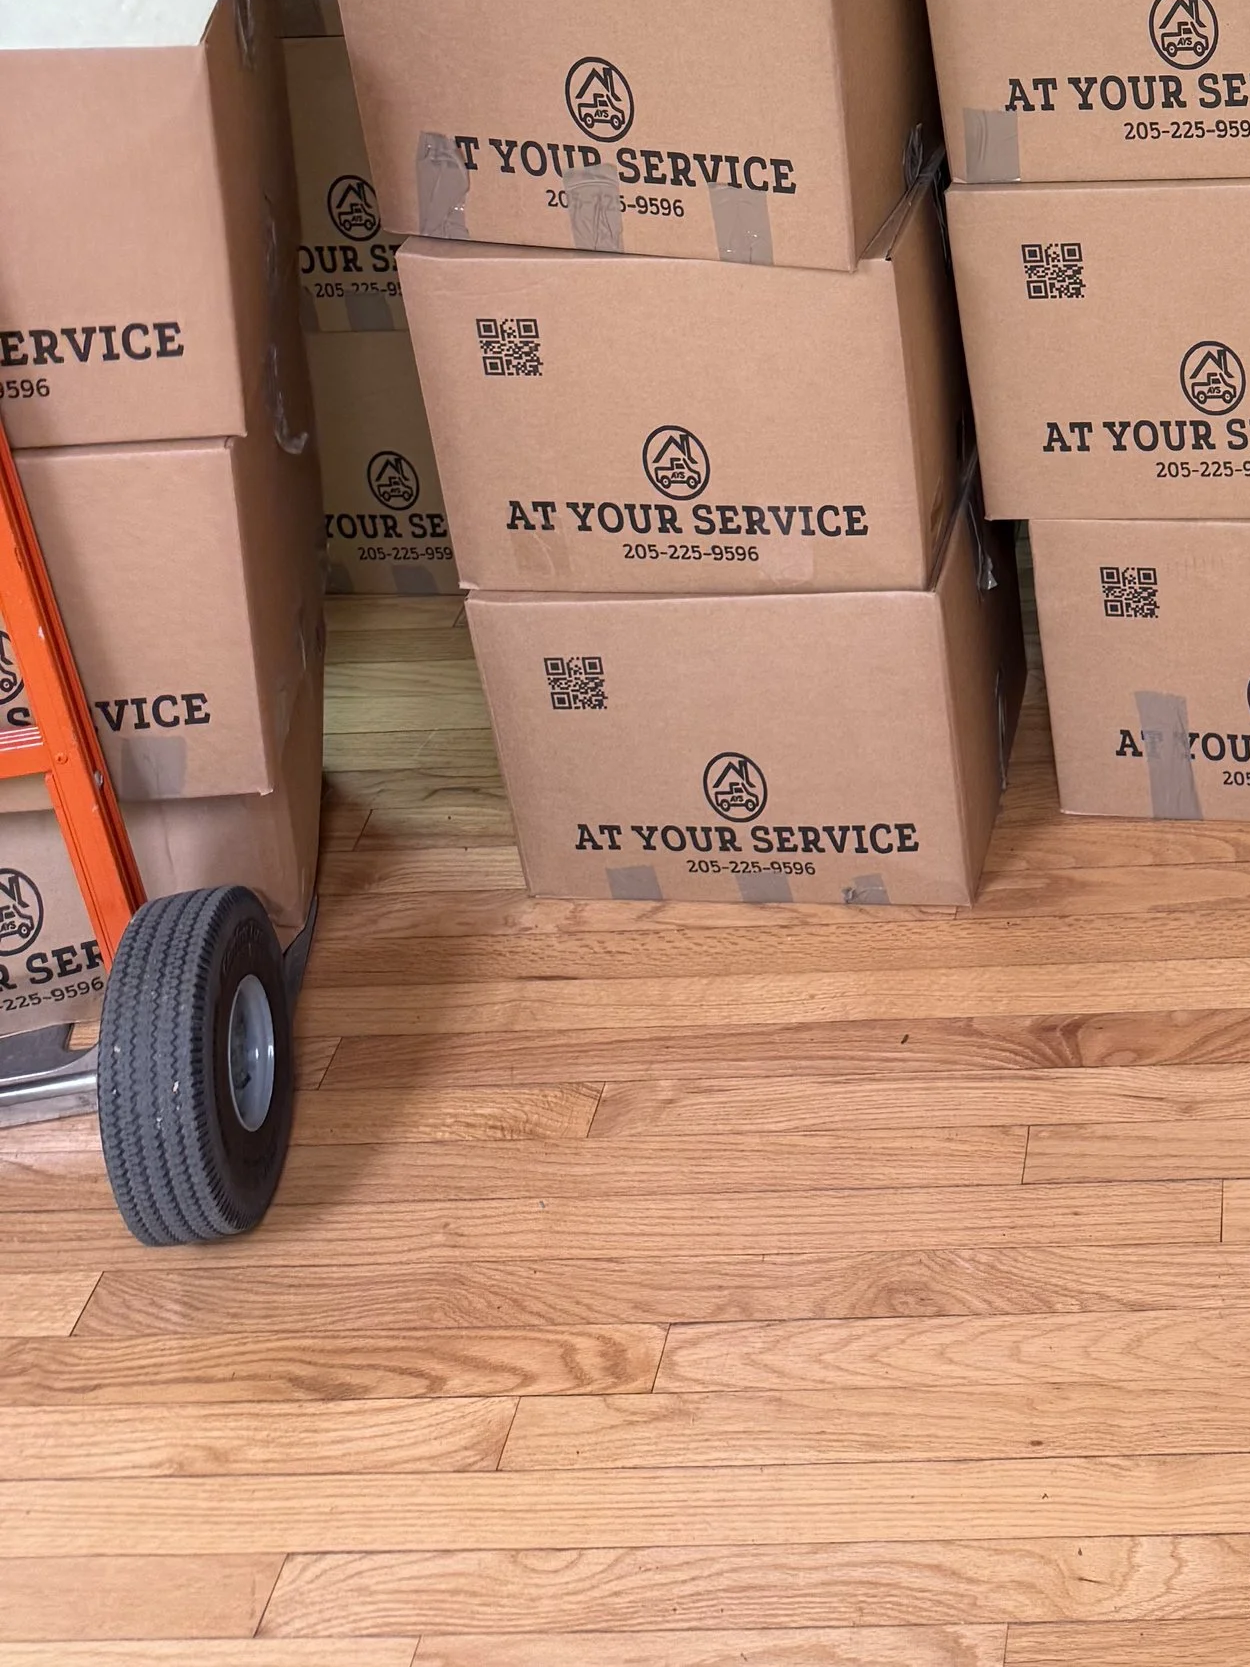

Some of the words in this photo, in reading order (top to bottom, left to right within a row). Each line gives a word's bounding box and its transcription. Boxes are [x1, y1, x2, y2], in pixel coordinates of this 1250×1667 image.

[1177, 37, 1193, 46] AYS
[1005, 78, 1057, 111] AT
[1068, 74, 1187, 110] YOUR
[594, 109, 609, 118] AYS
[617, 148, 796, 194] SERVICE
[1206, 386, 1222, 394] AYS
[1043, 422, 1092, 452] AT
[1103, 420, 1216, 451] YOUR
[670, 471, 685, 480] AYS
[507, 501, 556, 531] AT
[566, 502, 682, 534] YOUR
[692, 504, 868, 537] SERVICE
[622, 544, 759, 562] 205-225-9596
[730, 795, 744, 803] AYS
[575, 824, 622, 850] AT
[631, 824, 742, 852] YOUR
[751, 823, 919, 854] SERVICE
[686, 860, 816, 875] 205-225-9596
